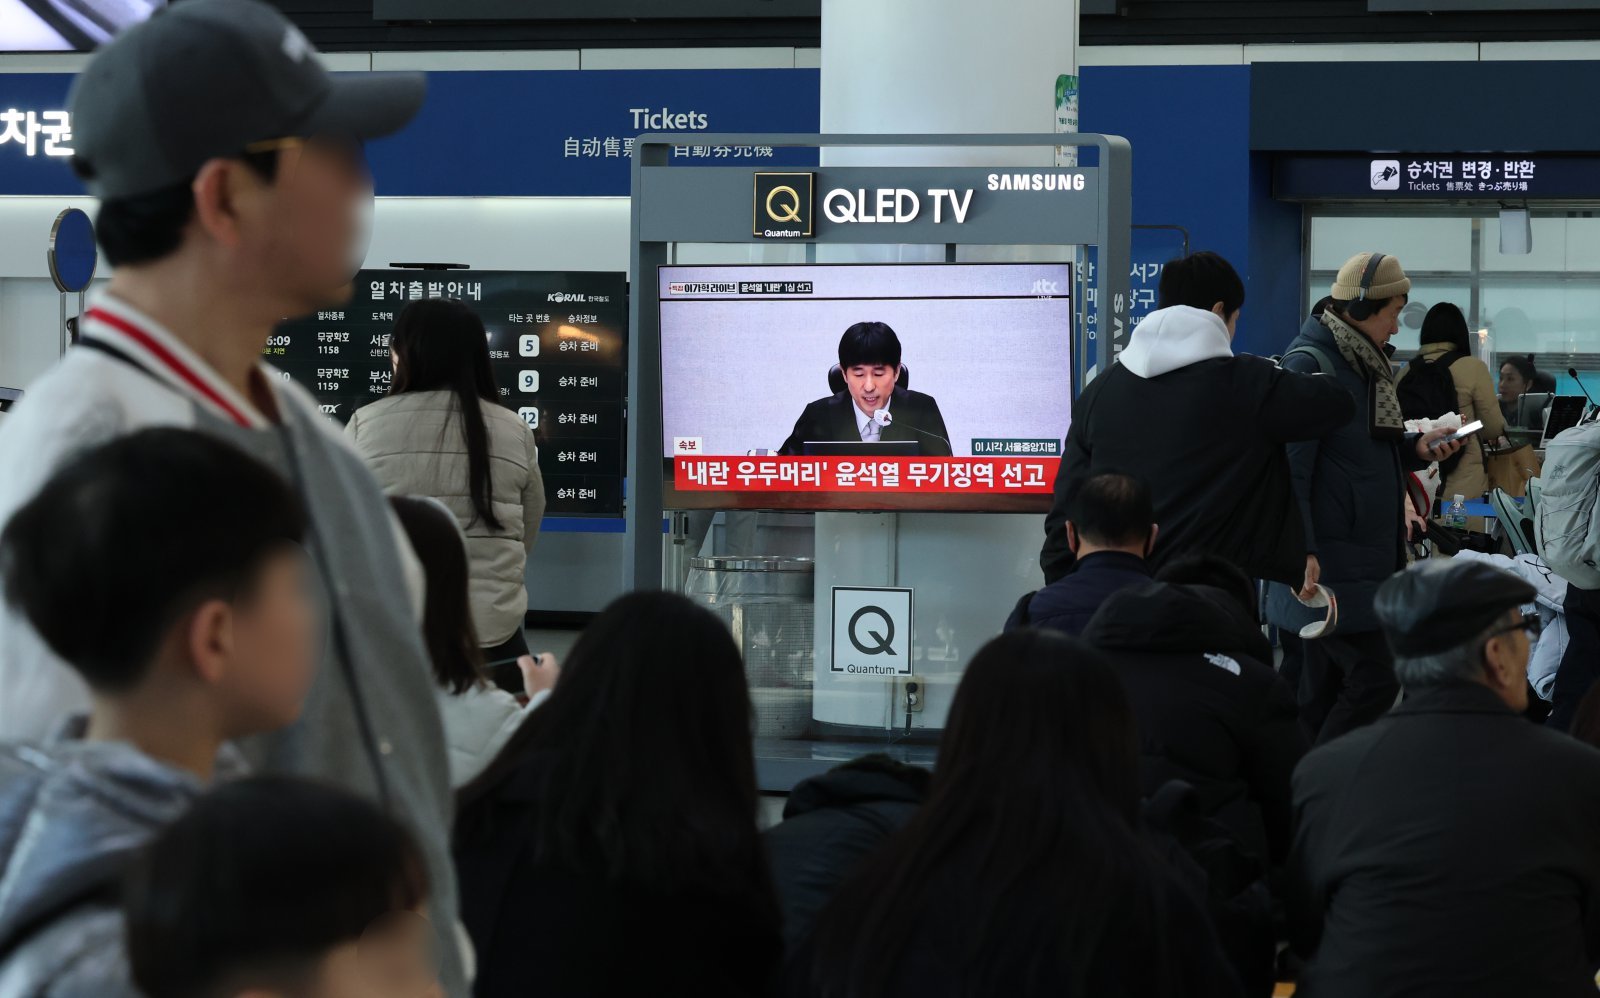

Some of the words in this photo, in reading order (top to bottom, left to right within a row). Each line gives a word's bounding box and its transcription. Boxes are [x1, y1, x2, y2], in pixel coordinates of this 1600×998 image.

[629, 107, 708, 130] Tickets
[1407, 160, 1453, 179] 승차권
[987, 173, 1085, 191] SAMSUNG
[1408, 181, 1440, 191] Tickets
[1446, 181, 1473, 191] 售票处
[1478, 181, 1528, 191] きっぷ売り場
[766, 185, 802, 223] Q
[823, 188, 920, 224] QLED
[928, 188, 974, 224] TV
[764, 229, 800, 237] Quantum
[741, 283, 763, 293] 윤석열
[785, 283, 795, 293] 1심
[797, 283, 812, 293] 선고
[547, 291, 586, 303] KORAIL
[317, 311, 346, 321] 열차종류
[371, 312, 394, 321] 도착역
[508, 314, 523, 323] 타는
[525, 314, 533, 323] 곳
[535, 313, 551, 323] 번호
[567, 314, 598, 323] 승차정보
[317, 332, 350, 343] 무궁화호
[318, 346, 340, 355] 1158
[525, 340, 534, 352] 5
[559, 341, 577, 351] 승차
[580, 341, 598, 352] 준비
[317, 368, 350, 379] 무궁화호
[369, 370, 392, 383] 부산
[317, 382, 339, 391] 1159
[525, 375, 534, 388] 9
[559, 376, 577, 387] 승차
[580, 376, 598, 387] 준비
[318, 403, 342, 414] KTX
[521, 411, 537, 425] 12
[558, 413, 576, 424] 승차
[579, 413, 597, 424] 준비
[678, 440, 697, 451] 속보
[975, 442, 984, 452] 이
[985, 442, 1003, 452] 시각
[1004, 442, 1057, 453] 서울중앙지법
[557, 451, 576, 462] 승차
[578, 451, 597, 462] 준비
[681, 461, 730, 486] '내란
[736, 461, 828, 487] 우두머리'
[835, 462, 900, 487] 윤석열
[907, 463, 994, 488] 무기징역
[1000, 463, 1046, 487] 선고
[557, 488, 575, 499] 승차
[578, 488, 596, 499] 준비
[848, 605, 898, 656] Q
[847, 664, 895, 675] Quantum
